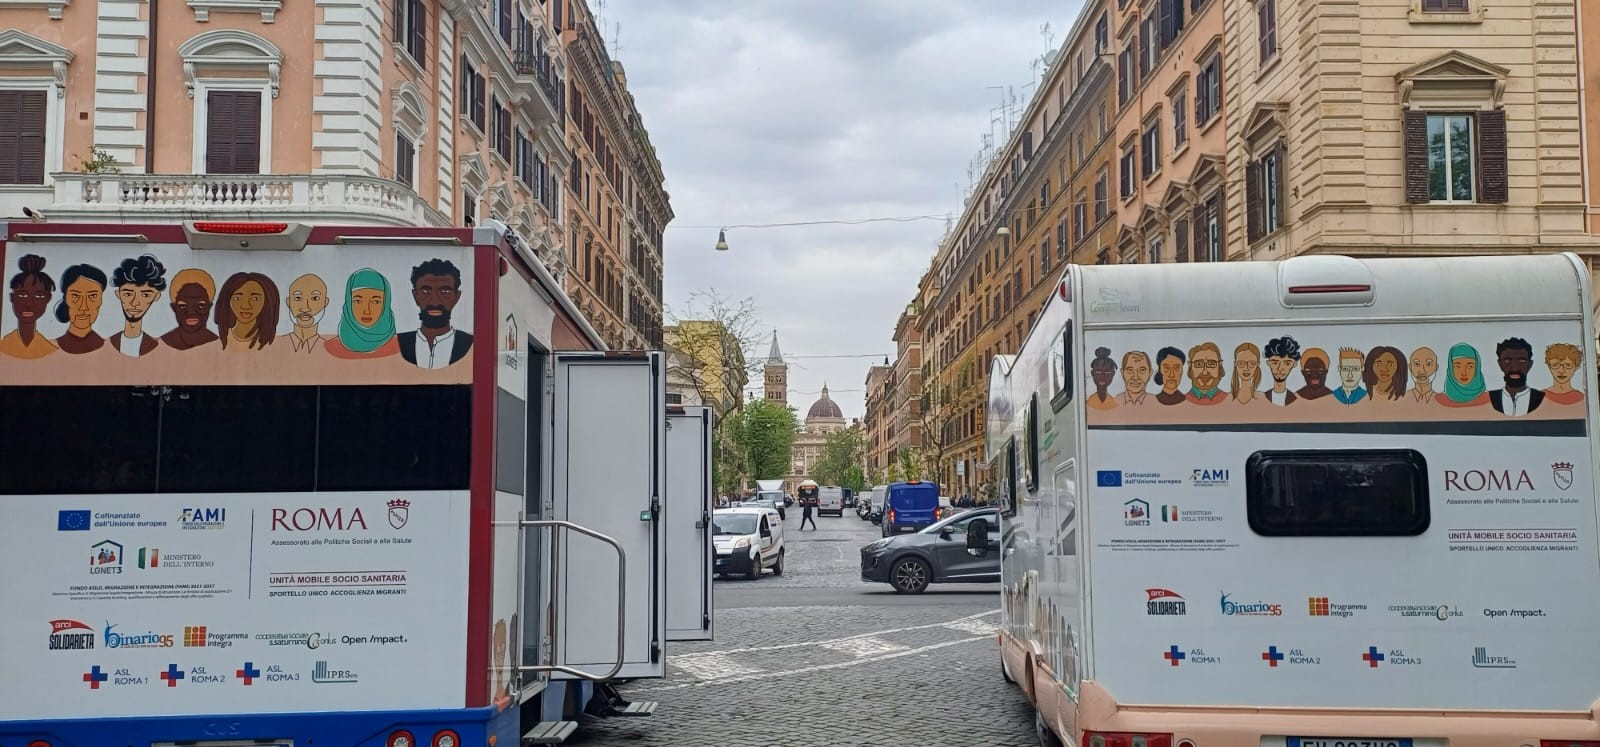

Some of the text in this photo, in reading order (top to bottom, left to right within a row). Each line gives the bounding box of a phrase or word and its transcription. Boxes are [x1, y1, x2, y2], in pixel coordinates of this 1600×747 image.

[1193, 469, 1229, 480] FAMI
[1444, 470, 1535, 491] ROMA
[182, 508, 226, 522] FAMI
[272, 507, 368, 532] ROMA
[1448, 531, 1471, 539] UNITÀ
[90, 566, 122, 575] LGNET3
[270, 574, 295, 584] UNITÀ
[298, 576, 330, 584] MOBILE
[362, 574, 406, 582] SANITARIA
[1147, 601, 1186, 616] SOLIDARIETA
[1220, 590, 1282, 616] binario95
[1483, 609, 1507, 617] Open
[104, 619, 174, 648] binario95
[49, 633, 94, 650] SOLIDARIETA
[342, 636, 366, 644] Open
[327, 670, 351, 679] IPRS
